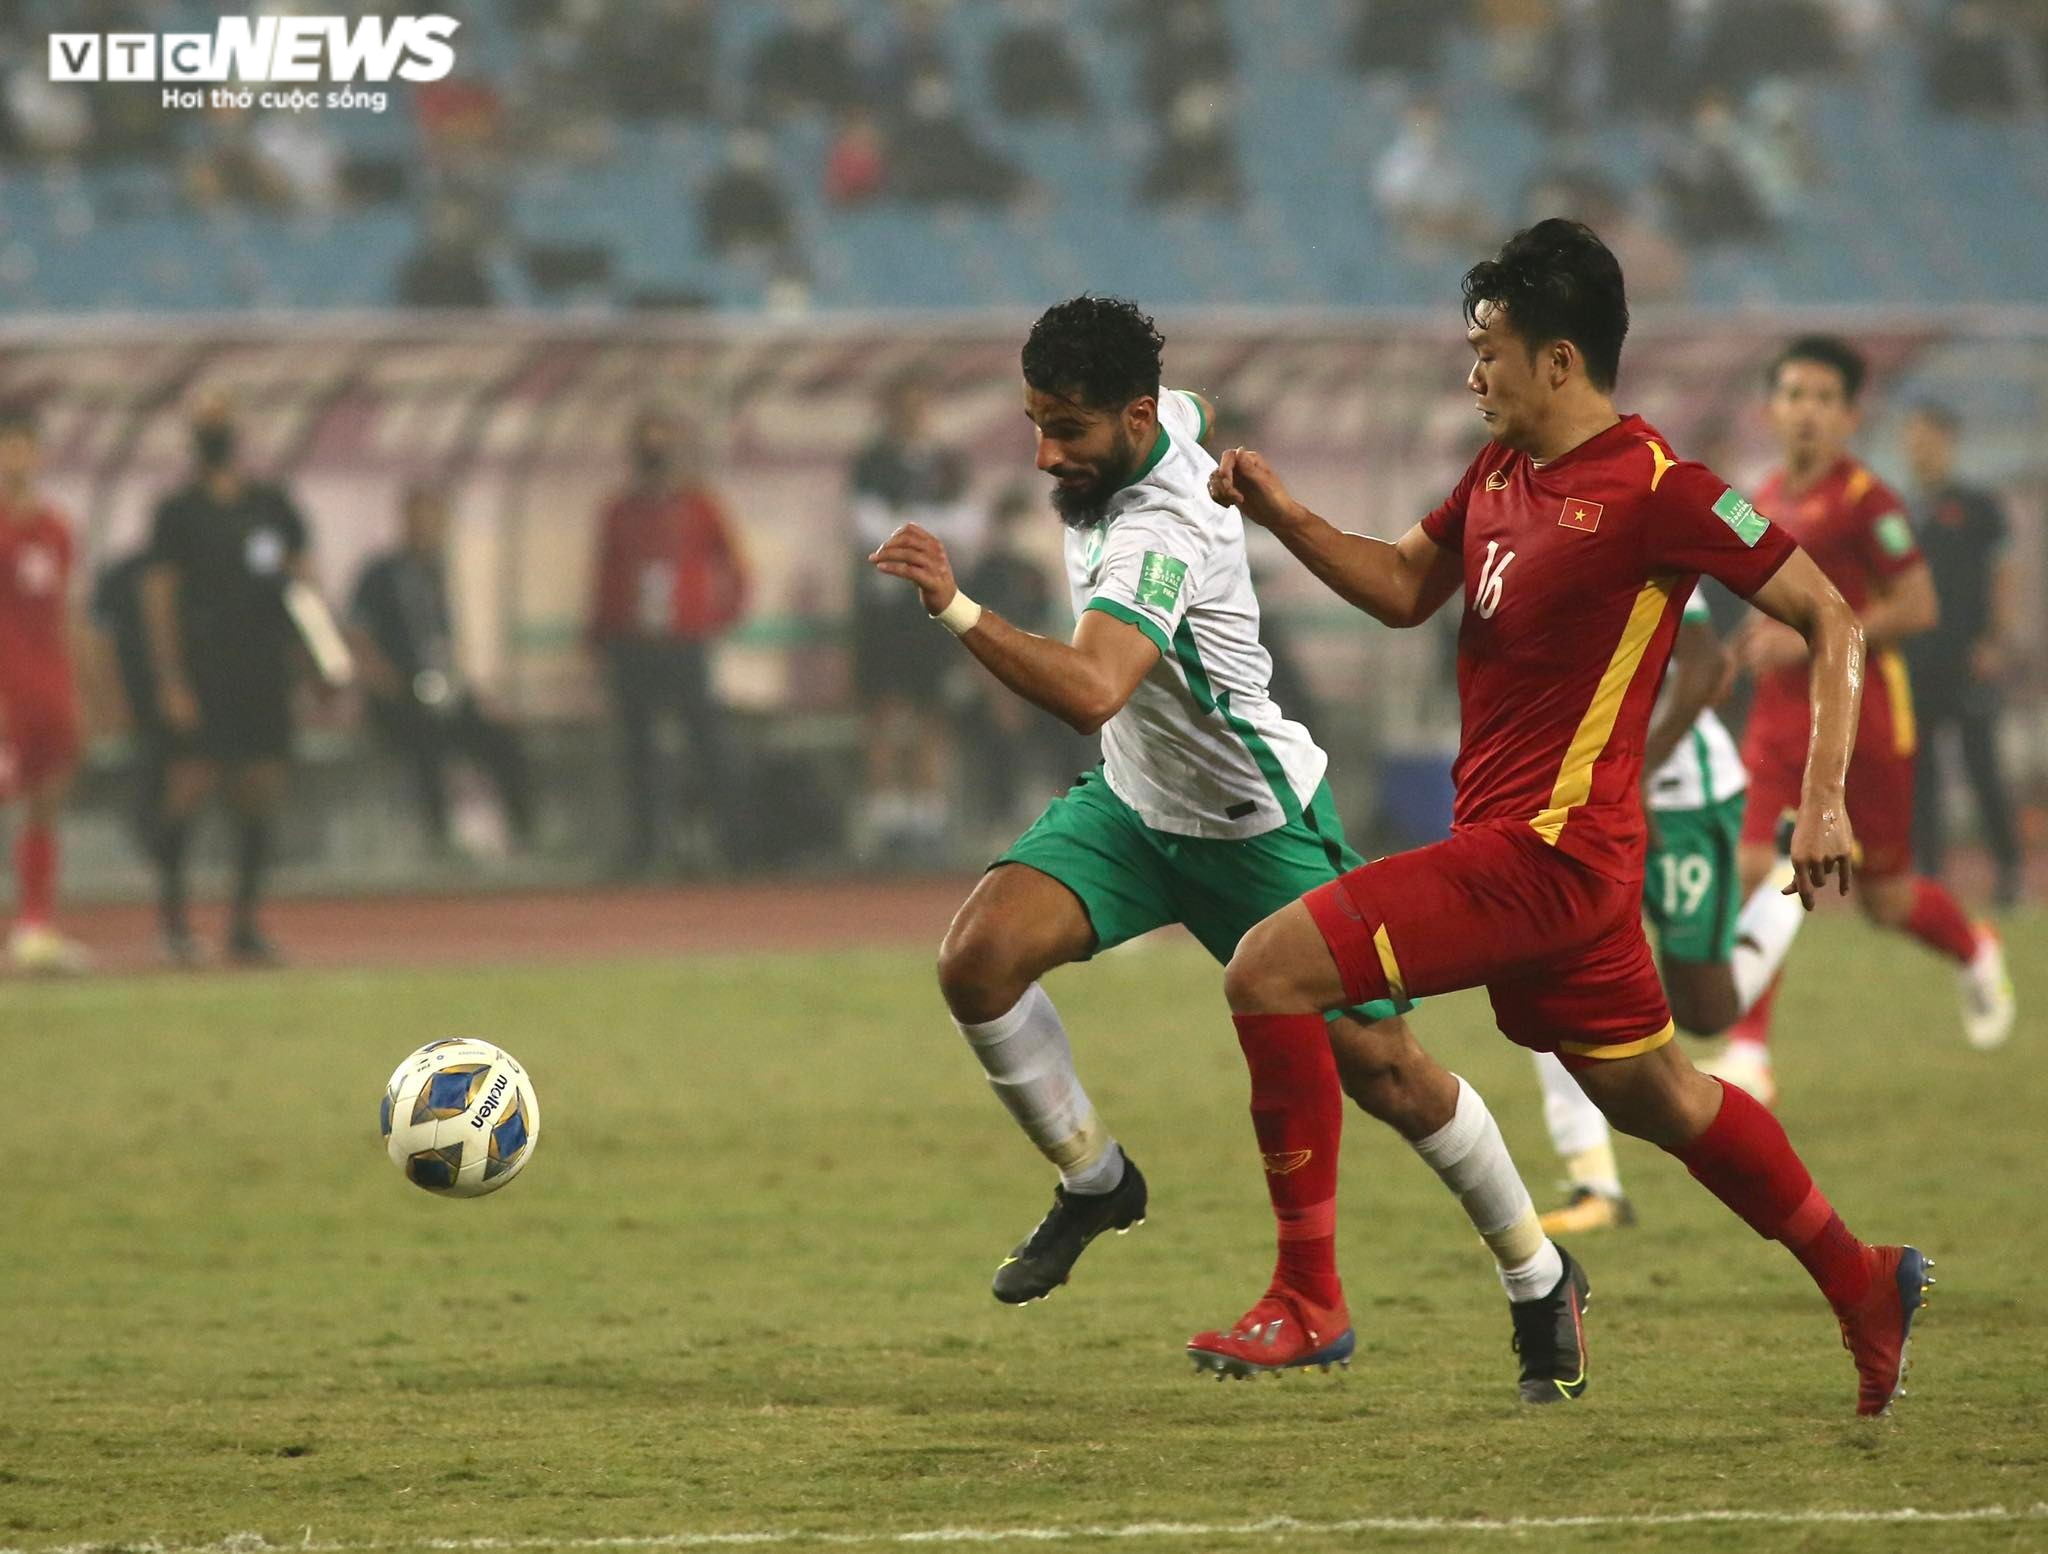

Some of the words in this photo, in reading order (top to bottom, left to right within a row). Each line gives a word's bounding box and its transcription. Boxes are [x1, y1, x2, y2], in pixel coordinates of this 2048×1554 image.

[1472, 540, 1516, 619] 16
[1661, 853, 1712, 915] 19
[470, 1074, 508, 1128] molten
